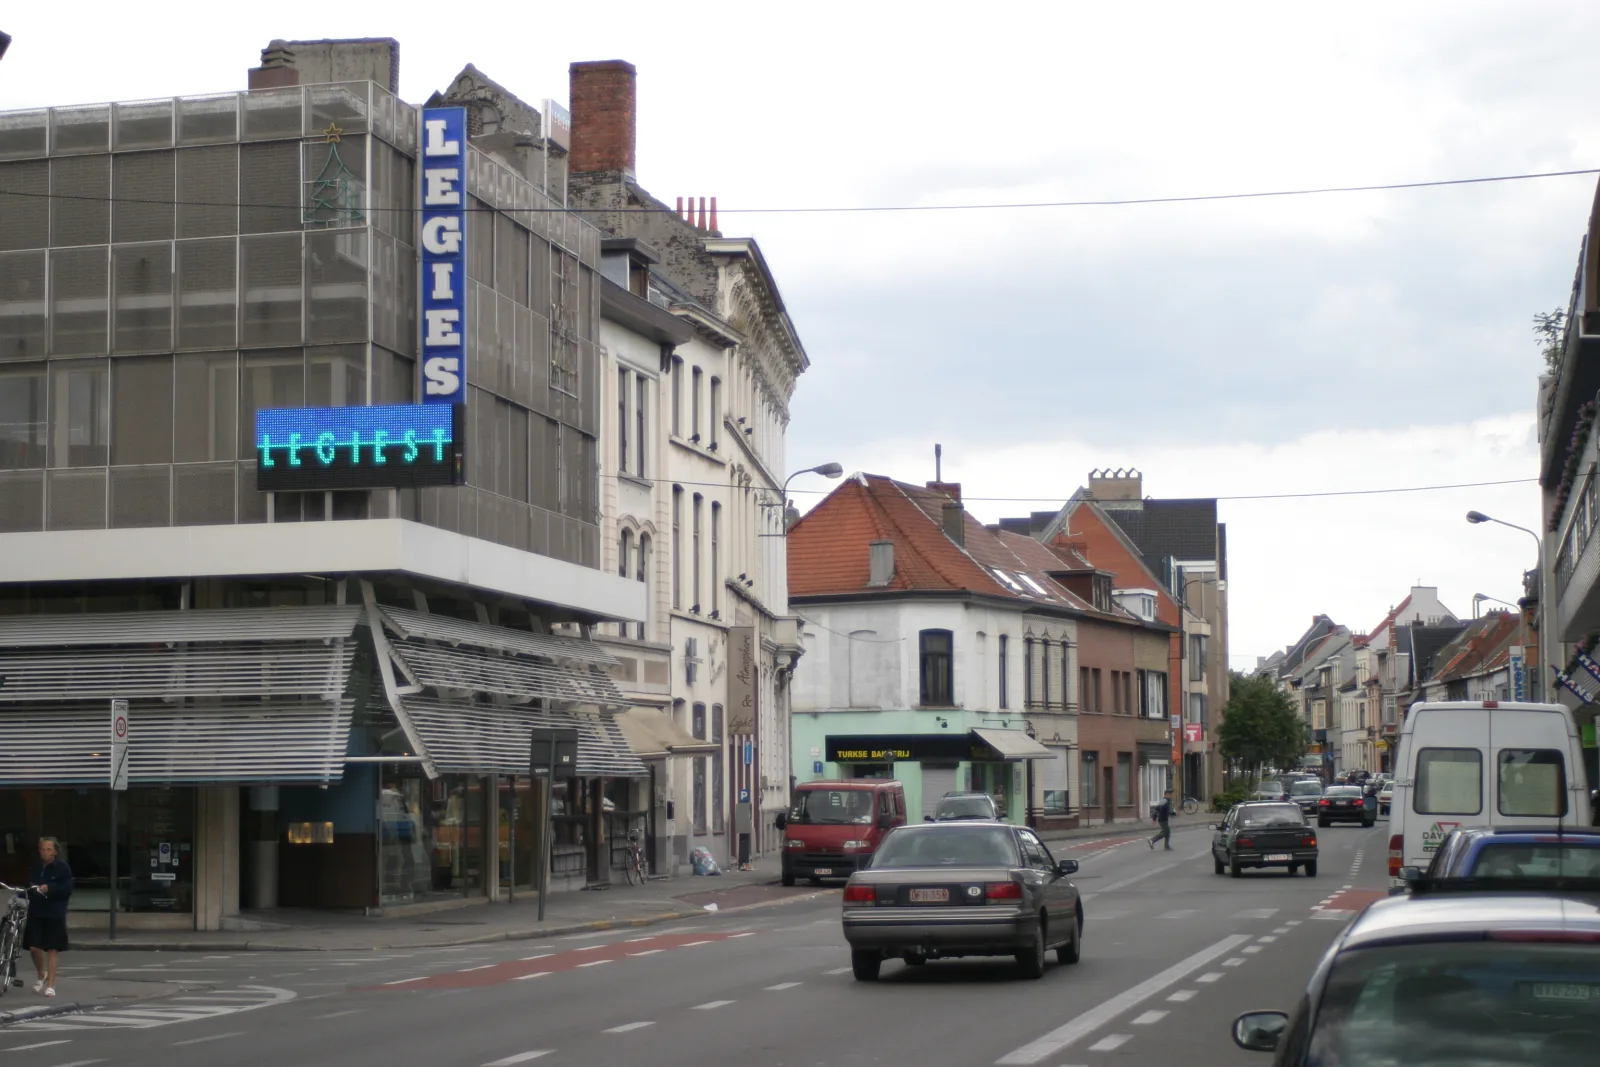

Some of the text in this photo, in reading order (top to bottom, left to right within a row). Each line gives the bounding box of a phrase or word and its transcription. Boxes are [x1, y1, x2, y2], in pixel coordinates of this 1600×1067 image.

[422, 119, 462, 395] LEGIES
[1556, 670, 1594, 703] HANS
[837, 750, 868, 758] TURKSE
[740, 791, 748, 800] P
